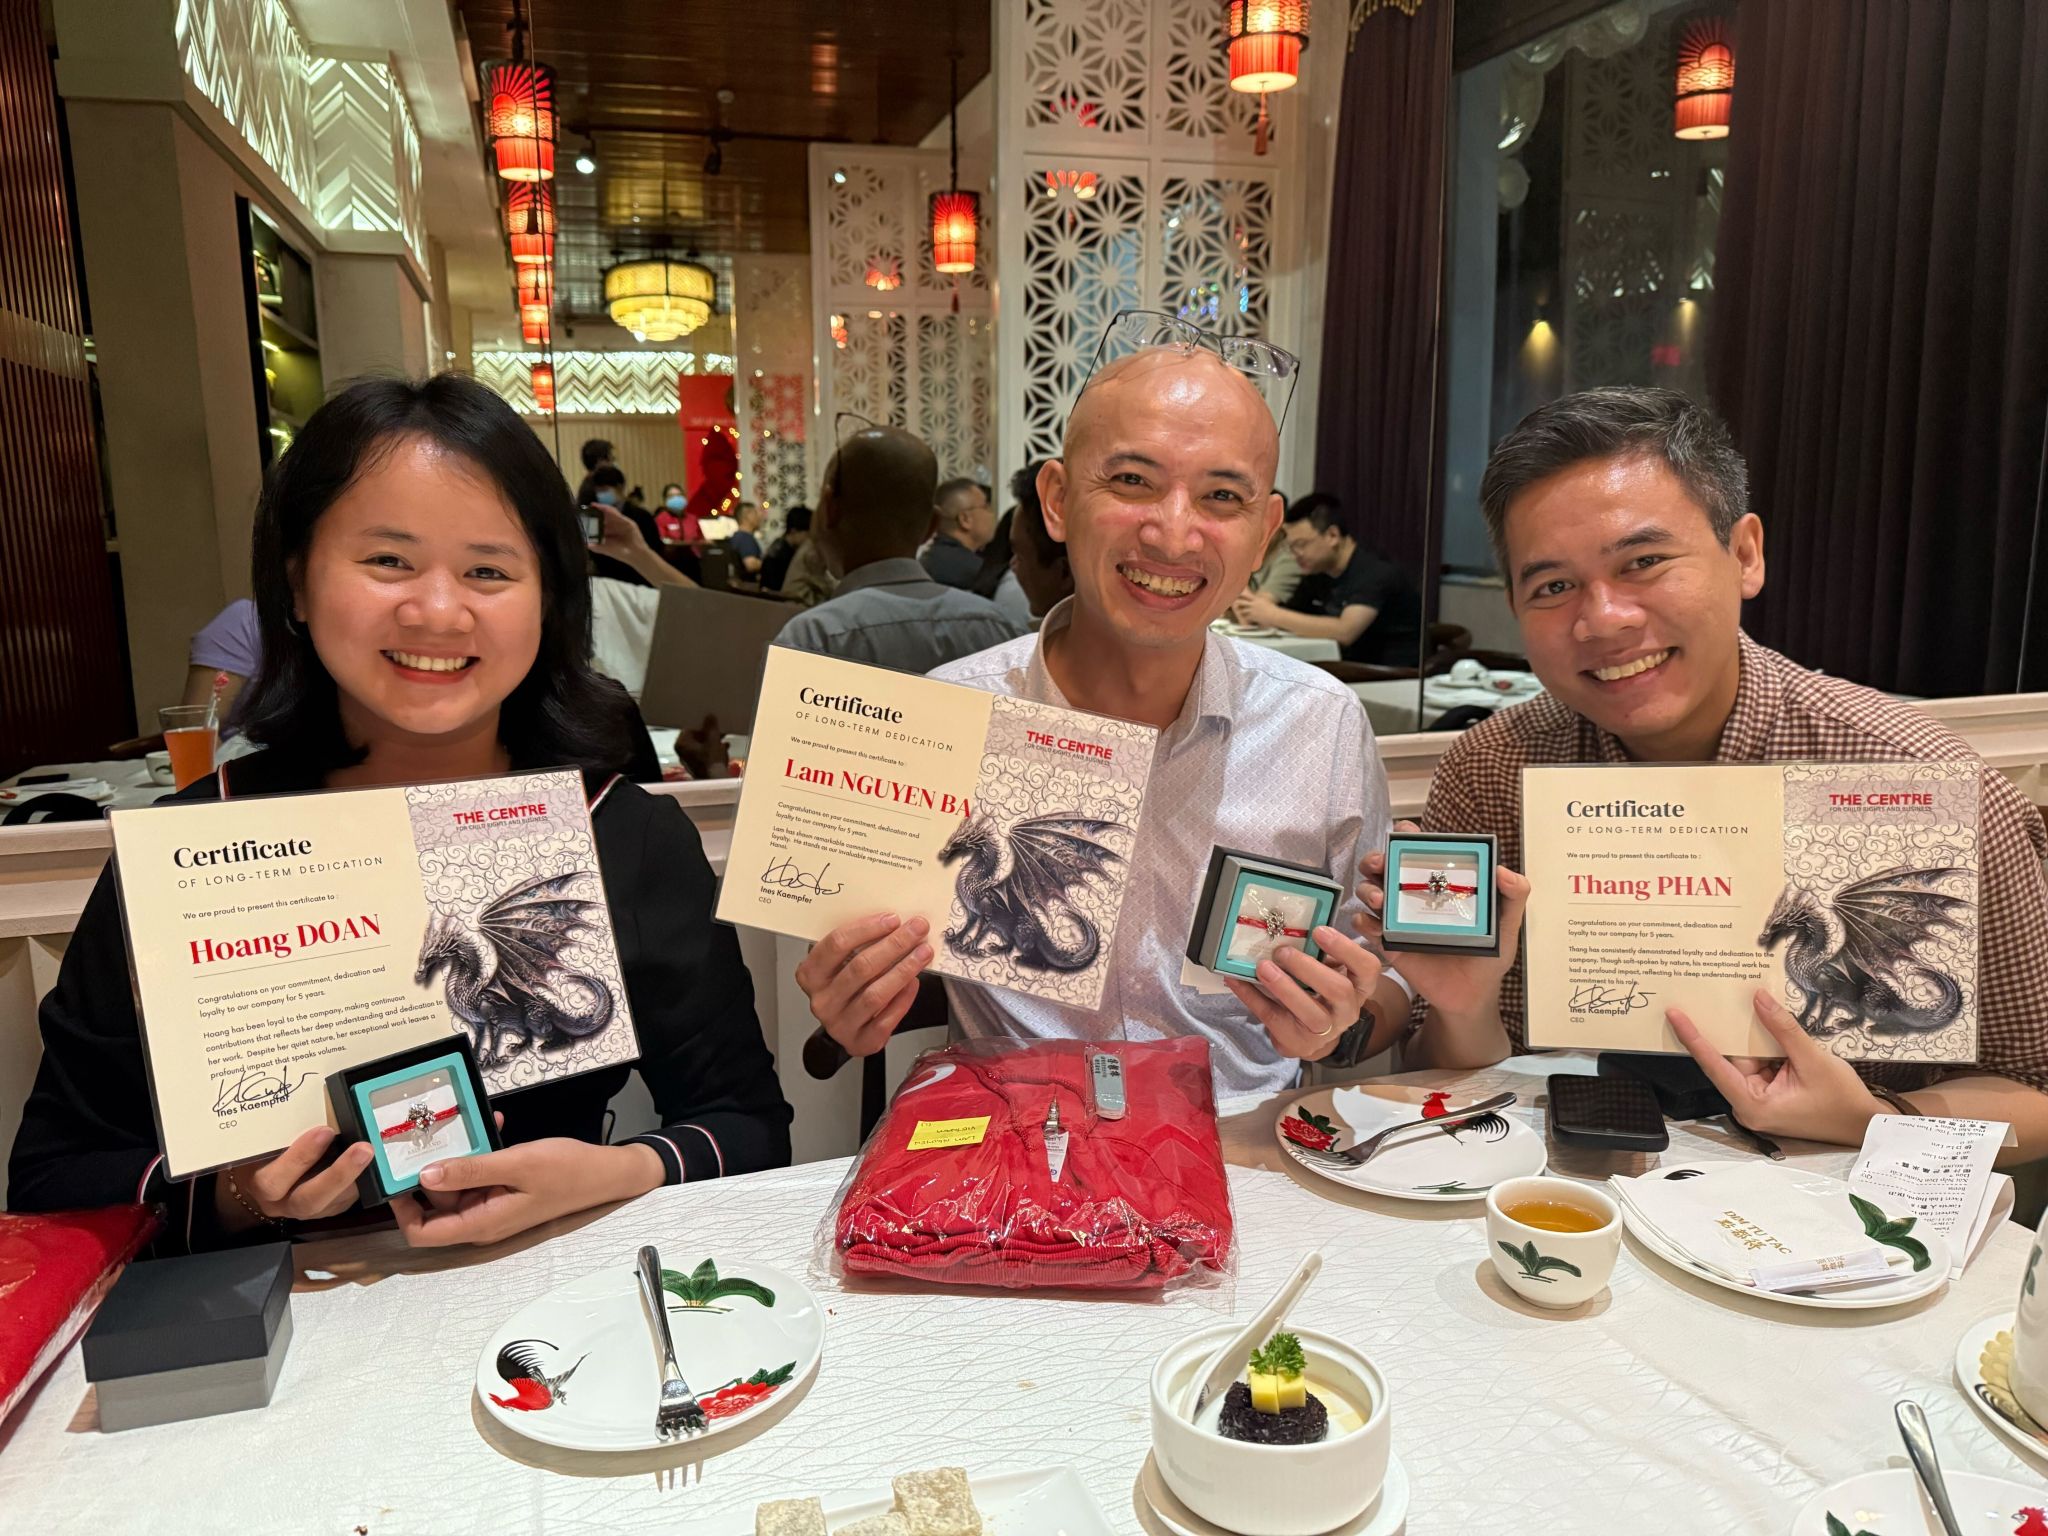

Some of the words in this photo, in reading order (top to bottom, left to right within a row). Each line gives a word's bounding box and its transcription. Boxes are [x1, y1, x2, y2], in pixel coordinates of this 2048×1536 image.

[799, 687, 903, 724] Certificate
[795, 711, 810, 720] OF
[815, 715, 880, 736] LONG-TERM
[885, 730, 953, 752] DEDICATION
[1026, 730, 1054, 747] THE
[1057, 738, 1113, 760] CENTRE
[785, 758, 834, 787] Lam
[840, 771, 936, 809] NGUYEN
[940, 793, 972, 820] BA
[1828, 794, 1862, 806] THE
[1864, 793, 1933, 806] CENTRE
[452, 811, 485, 825] THE
[488, 803, 547, 821] CENTRE
[1566, 800, 1685, 818] Certificate
[1566, 826, 1582, 834] OF
[1588, 826, 1662, 834] LONG-TERM
[1669, 826, 1748, 834] DEDICATION
[173, 839, 312, 868] Certificate
[1591, 851, 1610, 860] proud
[178, 878, 196, 889] OF
[205, 867, 292, 886] LONG-TERM
[299, 857, 382, 875] DEDICATION
[758, 896, 772, 904] CEO
[760, 885, 775, 895] Ines
[776, 889, 812, 904] Kaempfer
[1568, 874, 1651, 901] Thang
[1658, 876, 1731, 897] PHAN
[213, 906, 236, 918] proud
[247, 902, 274, 913] present
[275, 900, 288, 908] this
[289, 896, 326, 906] certificate
[1567, 919, 1618, 928] Congratulations
[1683, 921, 1718, 929] dedication
[1568, 929, 1589, 938] loyalty
[1639, 930, 1649, 938] for
[190, 933, 292, 965] Hoang
[296, 914, 380, 948] DOAN
[1568, 945, 1588, 954] Thang
[1600, 947, 1637, 956] consistently
[1637, 947, 1681, 955] demonstrated
[1682, 948, 1704, 958] loyalty
[1704, 949, 1718, 957] and
[1718, 949, 1754, 957] dedication
[1763, 950, 1775, 958] the
[1588, 966, 1617, 975] profound
[1642, 968, 1673, 978] reflecting
[1673, 969, 1682, 977] his
[1683, 969, 1701, 979] deep
[1701, 971, 1747, 981] understanding
[1600, 956, 1622, 966] Though
[1623, 957, 1659, 966] soft-spoken
[1660, 958, 1668, 967] by
[1692, 959, 1702, 967] his
[1702, 961, 1741, 969] exceptional
[1758, 961, 1770, 969] has
[197, 989, 259, 1005] Congratulations
[270, 984, 286, 994] your
[287, 976, 333, 989] commitment,
[333, 969, 371, 981] dedication
[372, 964, 386, 974] and
[199, 1007, 226, 1019] loyalty
[251, 998, 285, 1009] company
[286, 994, 297, 1002] for
[298, 992, 304, 1000] 5
[203, 1029, 230, 1039] Hoang
[230, 1025, 245, 1034] has
[245, 1022, 266, 1031] been
[266, 1016, 285, 1028] loyal
[295, 1013, 308, 1021] the
[309, 1008, 344, 1019] company,
[344, 1002, 370, 1011] making
[370, 995, 406, 1007] continuous
[1569, 1005, 1587, 1014] Ines
[1588, 1006, 1629, 1017] Kaempfer
[205, 1038, 255, 1053] contributions
[256, 1034, 272, 1042] that
[273, 1028, 301, 1039] reflects
[301, 1025, 313, 1033] her
[314, 1022, 334, 1031] deep
[335, 1012, 384, 1026] understanding
[384, 1007, 399, 1016] and
[399, 1002, 435, 1013] dedication
[207, 1057, 221, 1066] her
[222, 1052, 243, 1063] work.
[246, 1047, 276, 1058] Despite
[276, 1043, 289, 1051] her
[290, 1039, 309, 1050] quiet
[310, 1035, 336, 1045] nature,
[335, 1031, 348, 1039] her
[349, 1021, 390, 1036] exceptional
[390, 1017, 408, 1027] work
[407, 1015, 430, 1024] leaves
[210, 1064, 247, 1081] profound
[246, 1060, 274, 1071] impact
[274, 1056, 290, 1065] that
[291, 1050, 317, 1063] speaks
[215, 1105, 238, 1117] Ines
[239, 1092, 291, 1112] Kaempfer
[219, 1119, 238, 1130] CEO
[1723, 1211, 1750, 1224] DIM
[1748, 1225, 1768, 1236] TU
[1765, 1236, 1792, 1254] TAC
